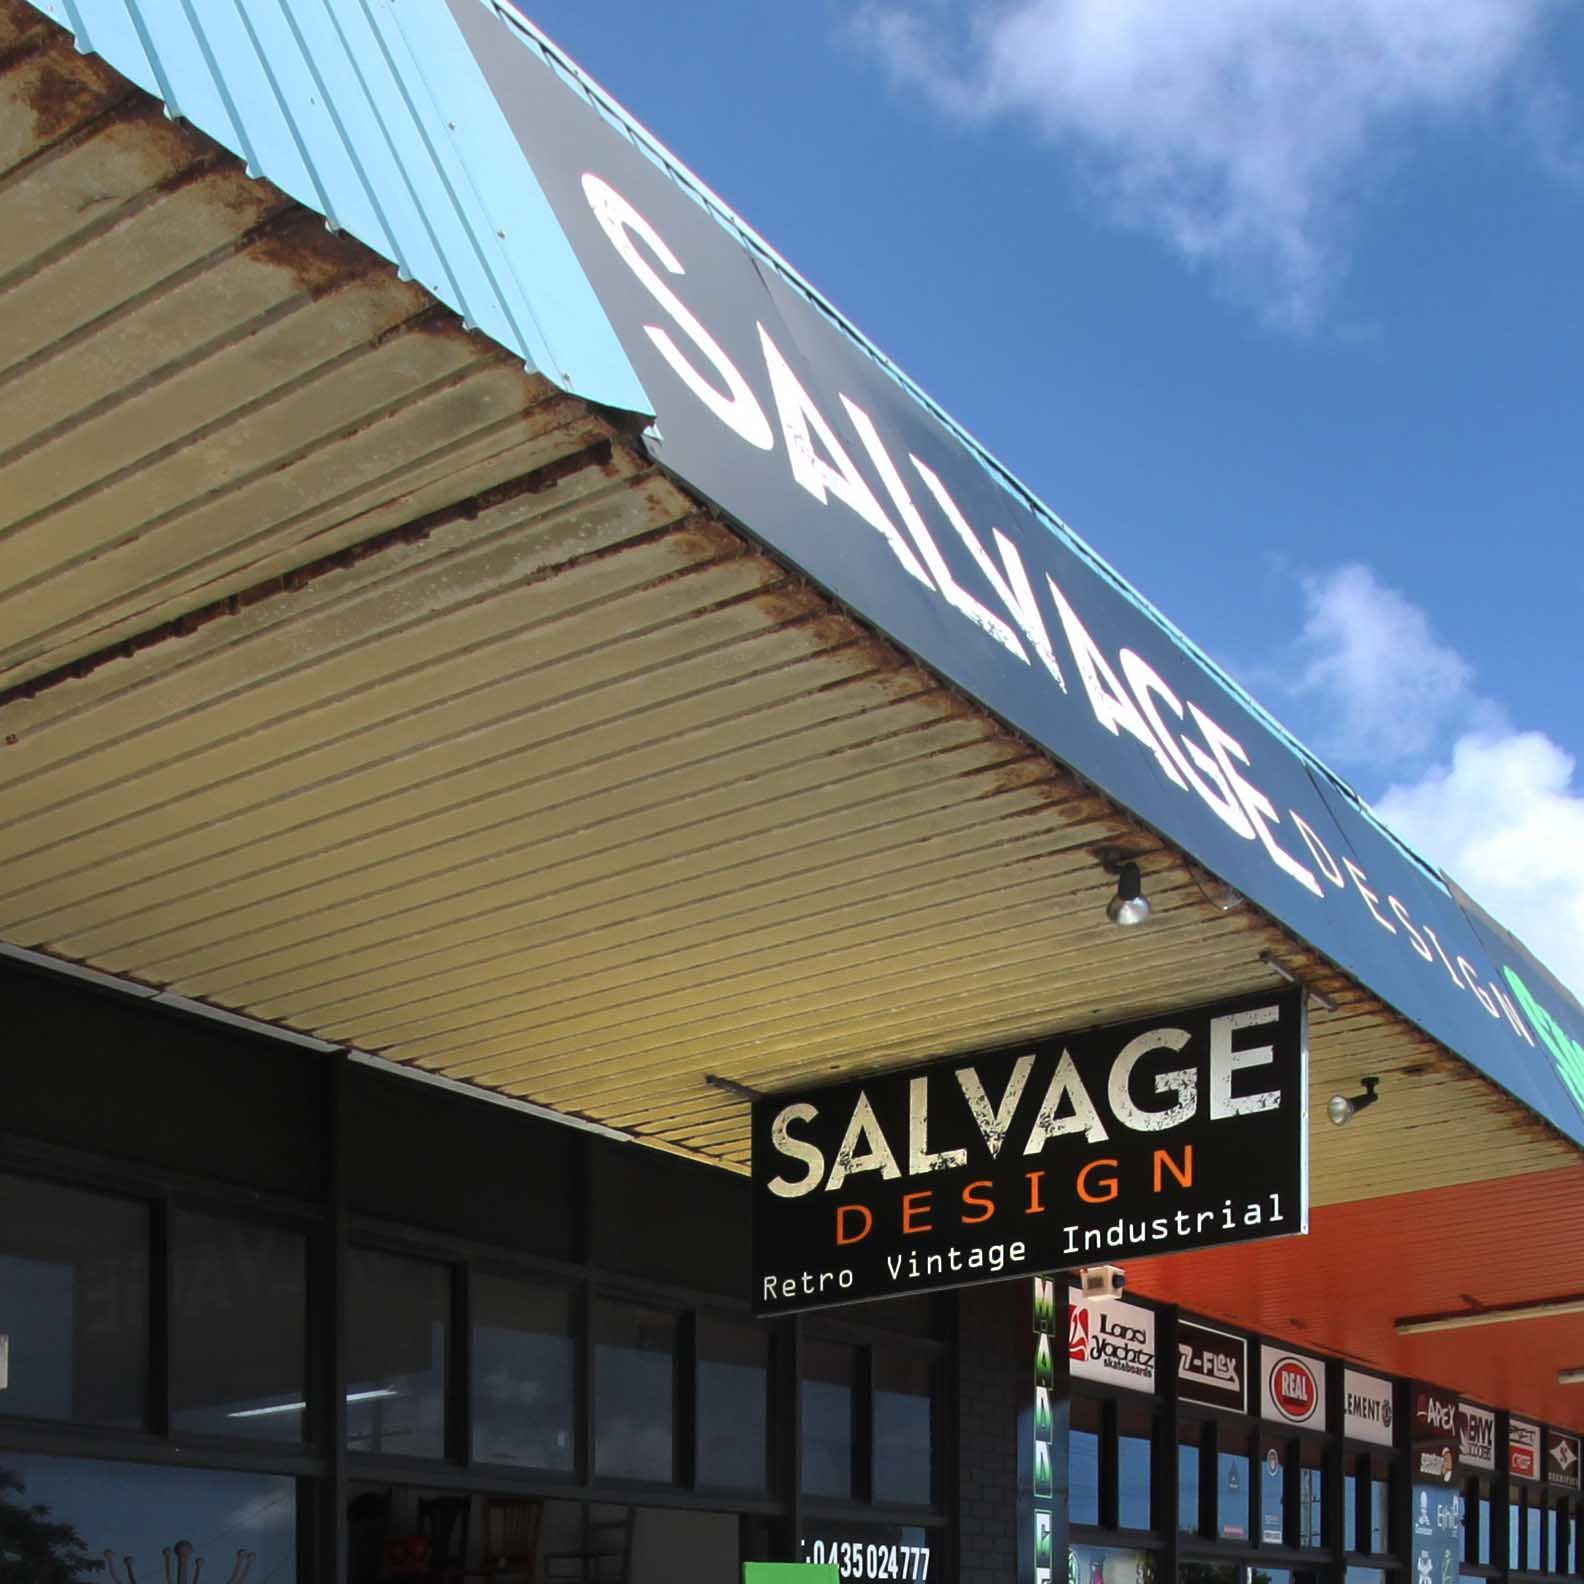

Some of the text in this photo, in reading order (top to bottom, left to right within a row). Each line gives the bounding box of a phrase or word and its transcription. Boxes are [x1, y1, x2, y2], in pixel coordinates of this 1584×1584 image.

[580, 172, 1325, 899] SALVAGE
[1288, 809, 1535, 1047] DESIGN
[767, 1005, 1282, 1198] SALVAGE
[835, 1144, 1195, 1246] DESIGN
[763, 1194, 1284, 1301] Retro Vintage Industrial
[1281, 1370, 1308, 1400] REAL
[1343, 1392, 1381, 1421] EMENT
[1426, 1397, 1456, 1437] APEX
